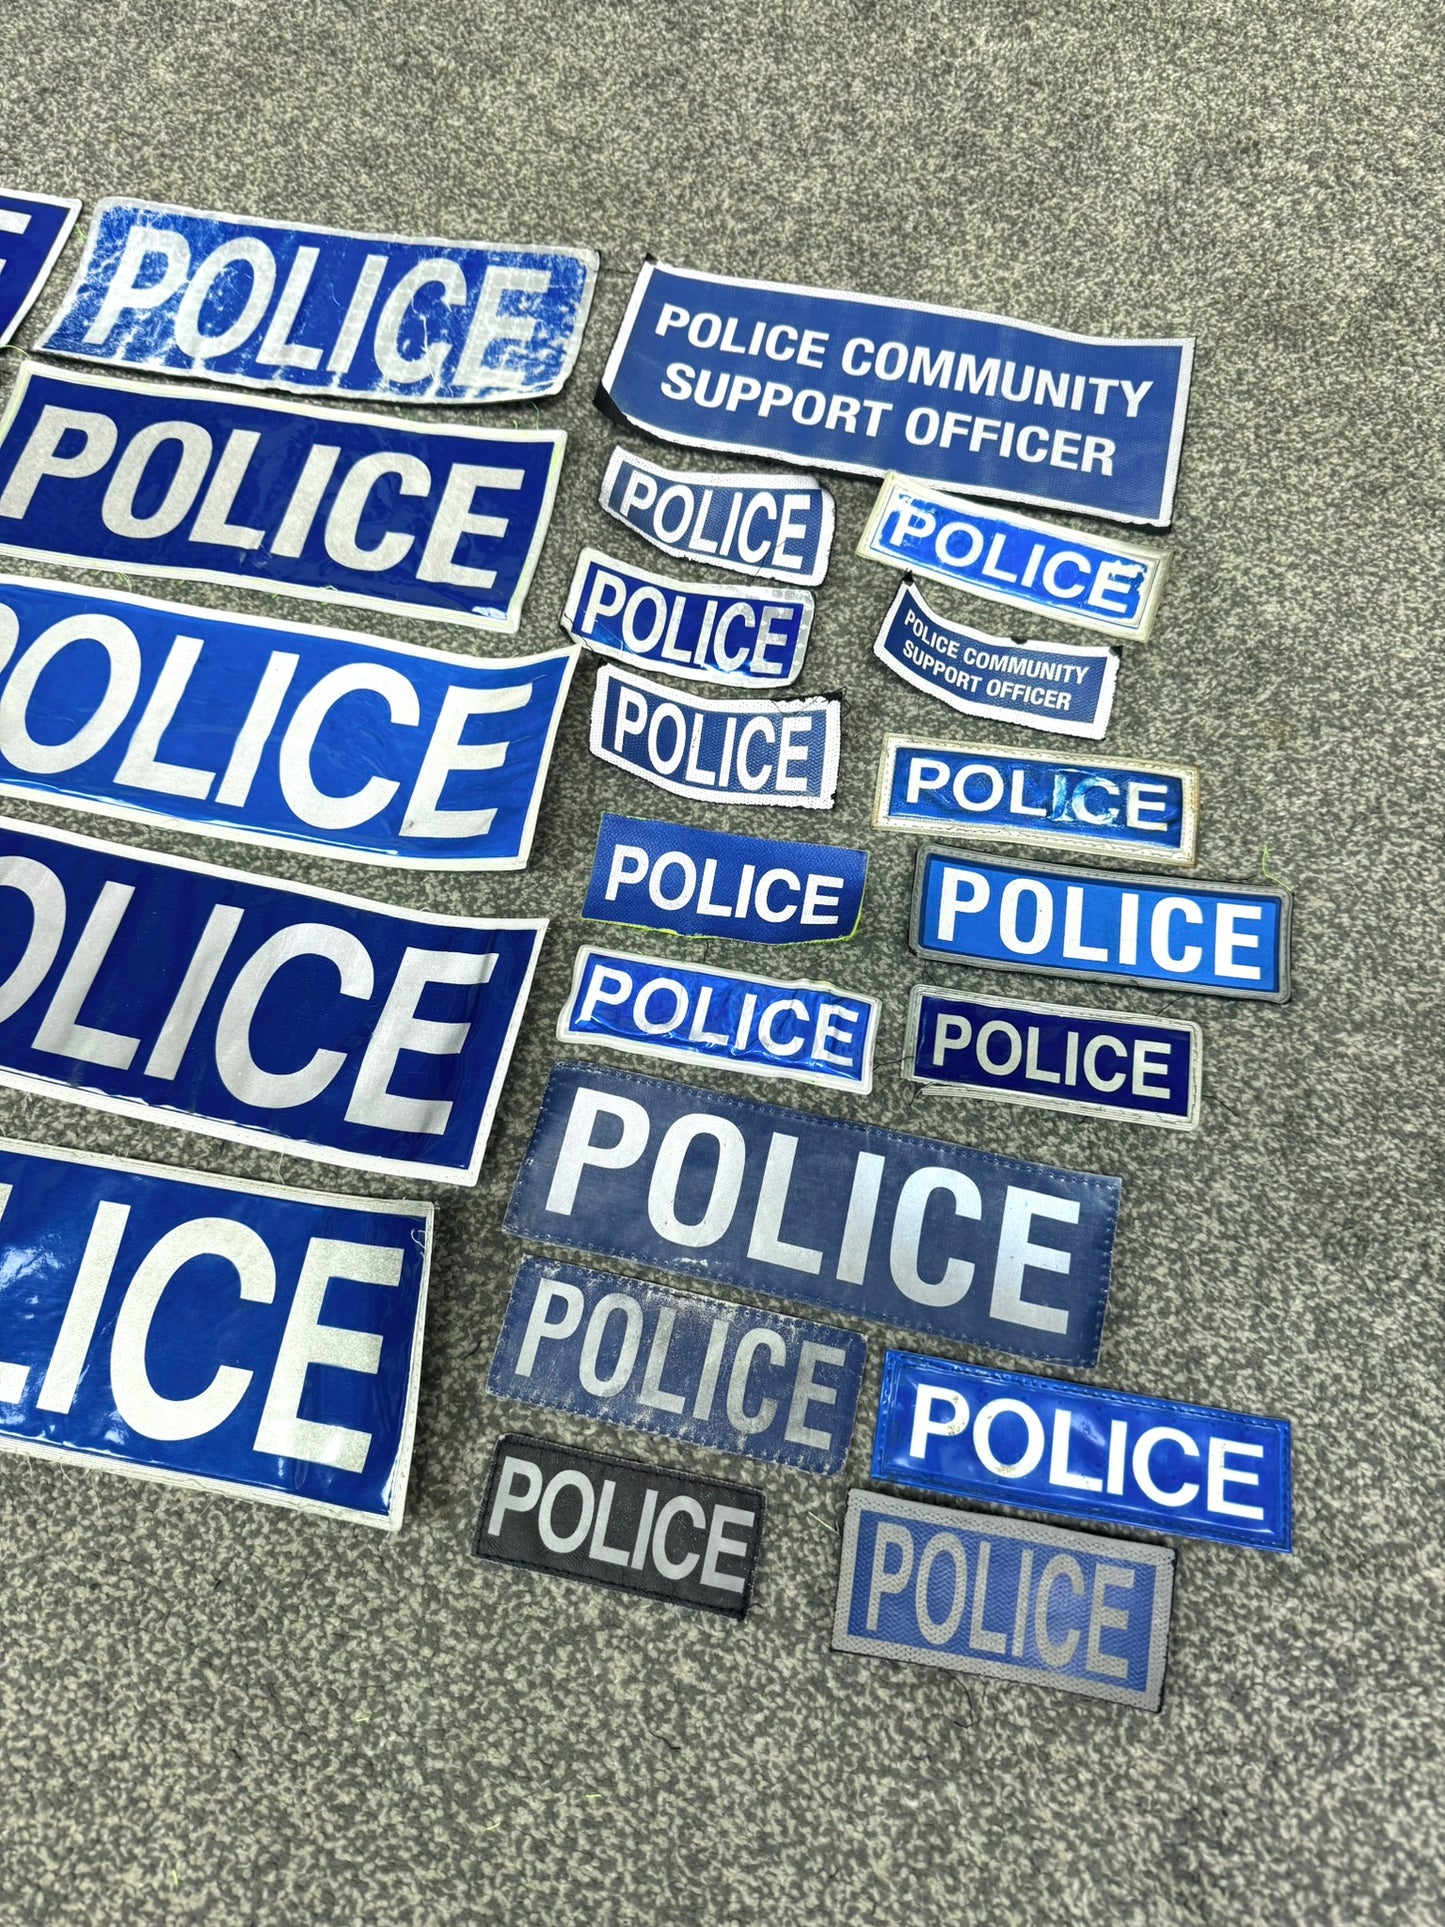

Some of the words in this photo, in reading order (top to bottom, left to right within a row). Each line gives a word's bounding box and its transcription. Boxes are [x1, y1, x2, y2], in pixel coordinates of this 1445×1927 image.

[85, 228, 551, 388] POLICE
[654, 303, 831, 368] POLICE
[841, 336, 1153, 418] COMMUNITY
[660, 362, 893, 438] SUPPORT
[904, 406, 1117, 477] OFFICER
[0, 404, 525, 588] POLICE
[623, 469, 811, 569] POLICE
[890, 496, 1139, 614] POLICE
[584, 574, 794, 675] POLICE
[903, 641, 984, 693] SUPPORT
[985, 679, 1073, 711] OFFICER
[905, 609, 960, 659] POLICE
[963, 647, 1090, 685] COMMUNITY
[614, 688, 812, 791] POLICE
[906, 756, 1169, 832] POLICE
[604, 843, 845, 926] POLICE
[938, 866, 1265, 981] POLICE
[577, 964, 860, 1068] POLICE
[932, 1014, 1172, 1100] POLICE
[545, 1086, 1081, 1335] POLICE
[515, 1278, 848, 1450] POLICE
[909, 1384, 1266, 1520] POLICE
[486, 1455, 756, 1594] POLICE
[866, 1523, 1136, 1680] POLICE
